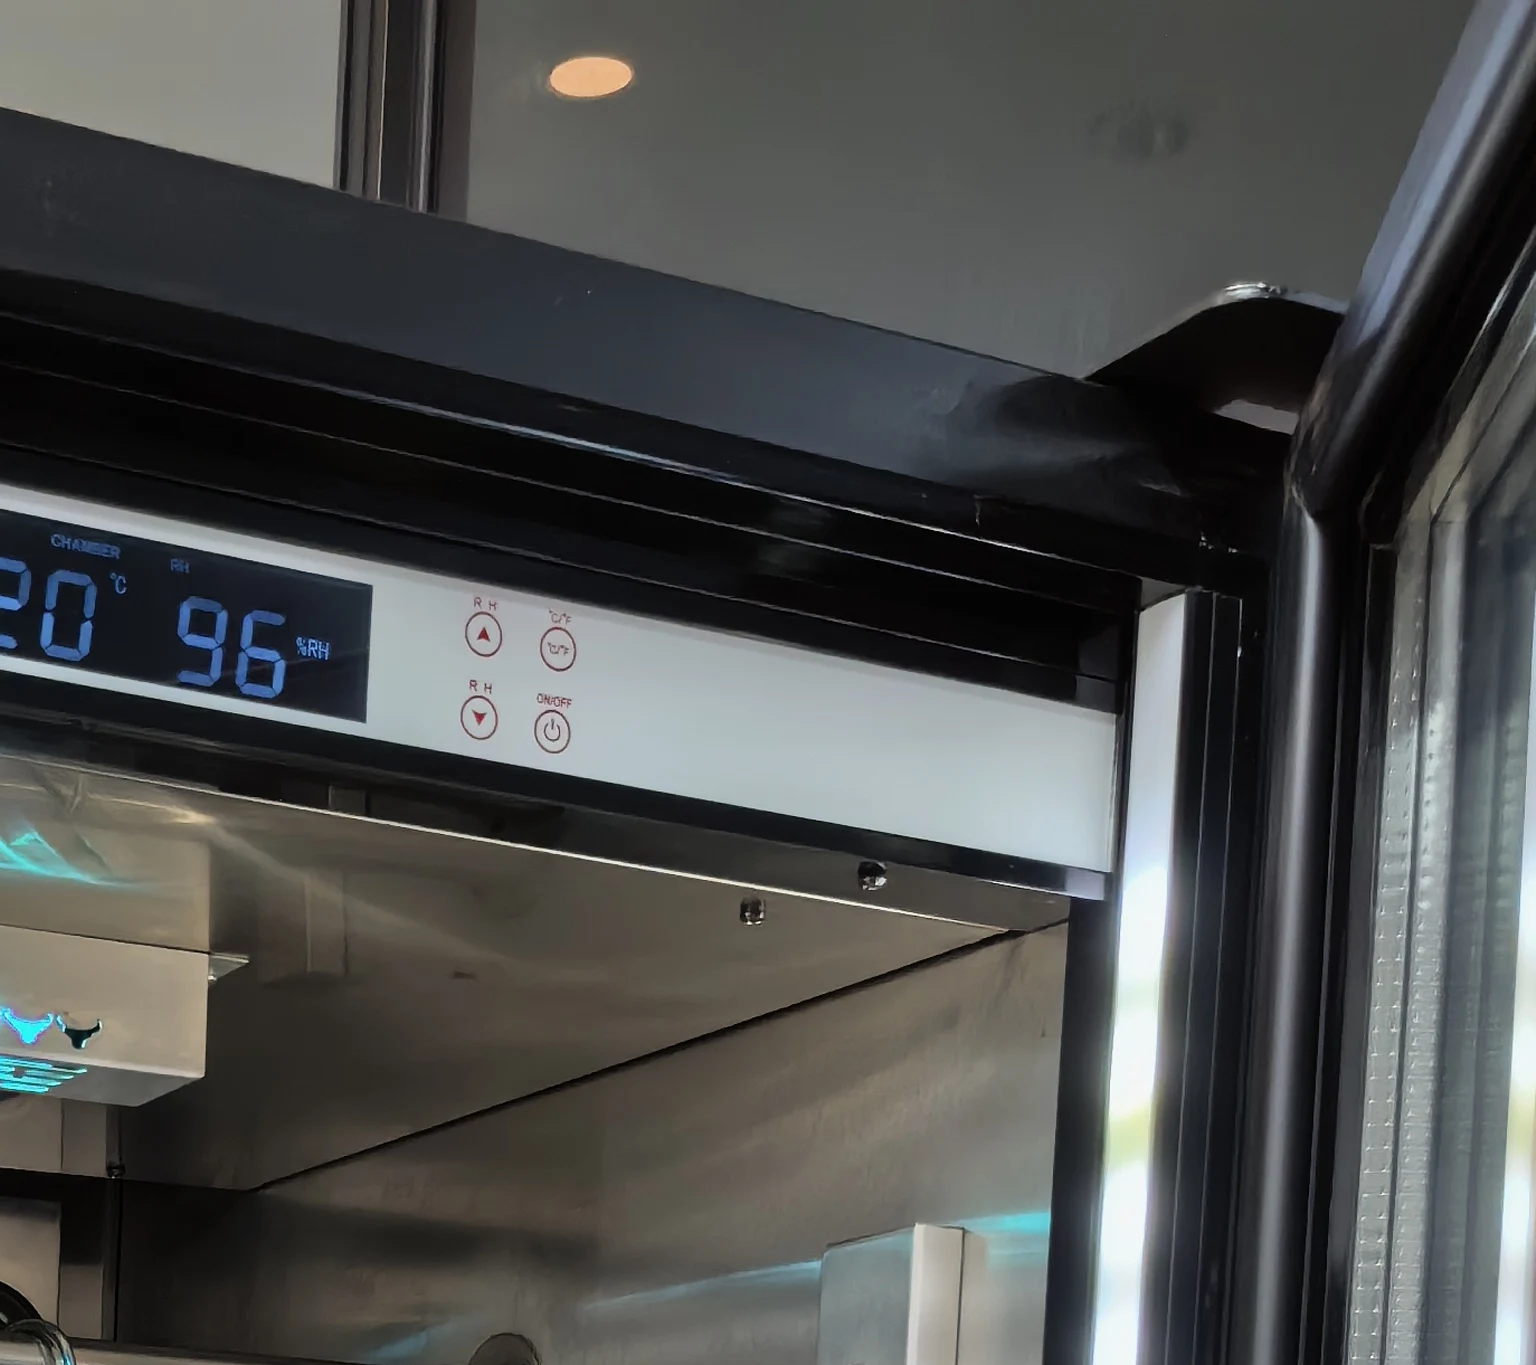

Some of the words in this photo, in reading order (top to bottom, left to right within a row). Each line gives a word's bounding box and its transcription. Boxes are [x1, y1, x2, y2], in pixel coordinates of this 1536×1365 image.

[50, 533, 121, 560] CHAMBER
[170, 557, 190, 574] RH
[176, 595, 286, 699] 96
[296, 635, 330, 661] %RH
